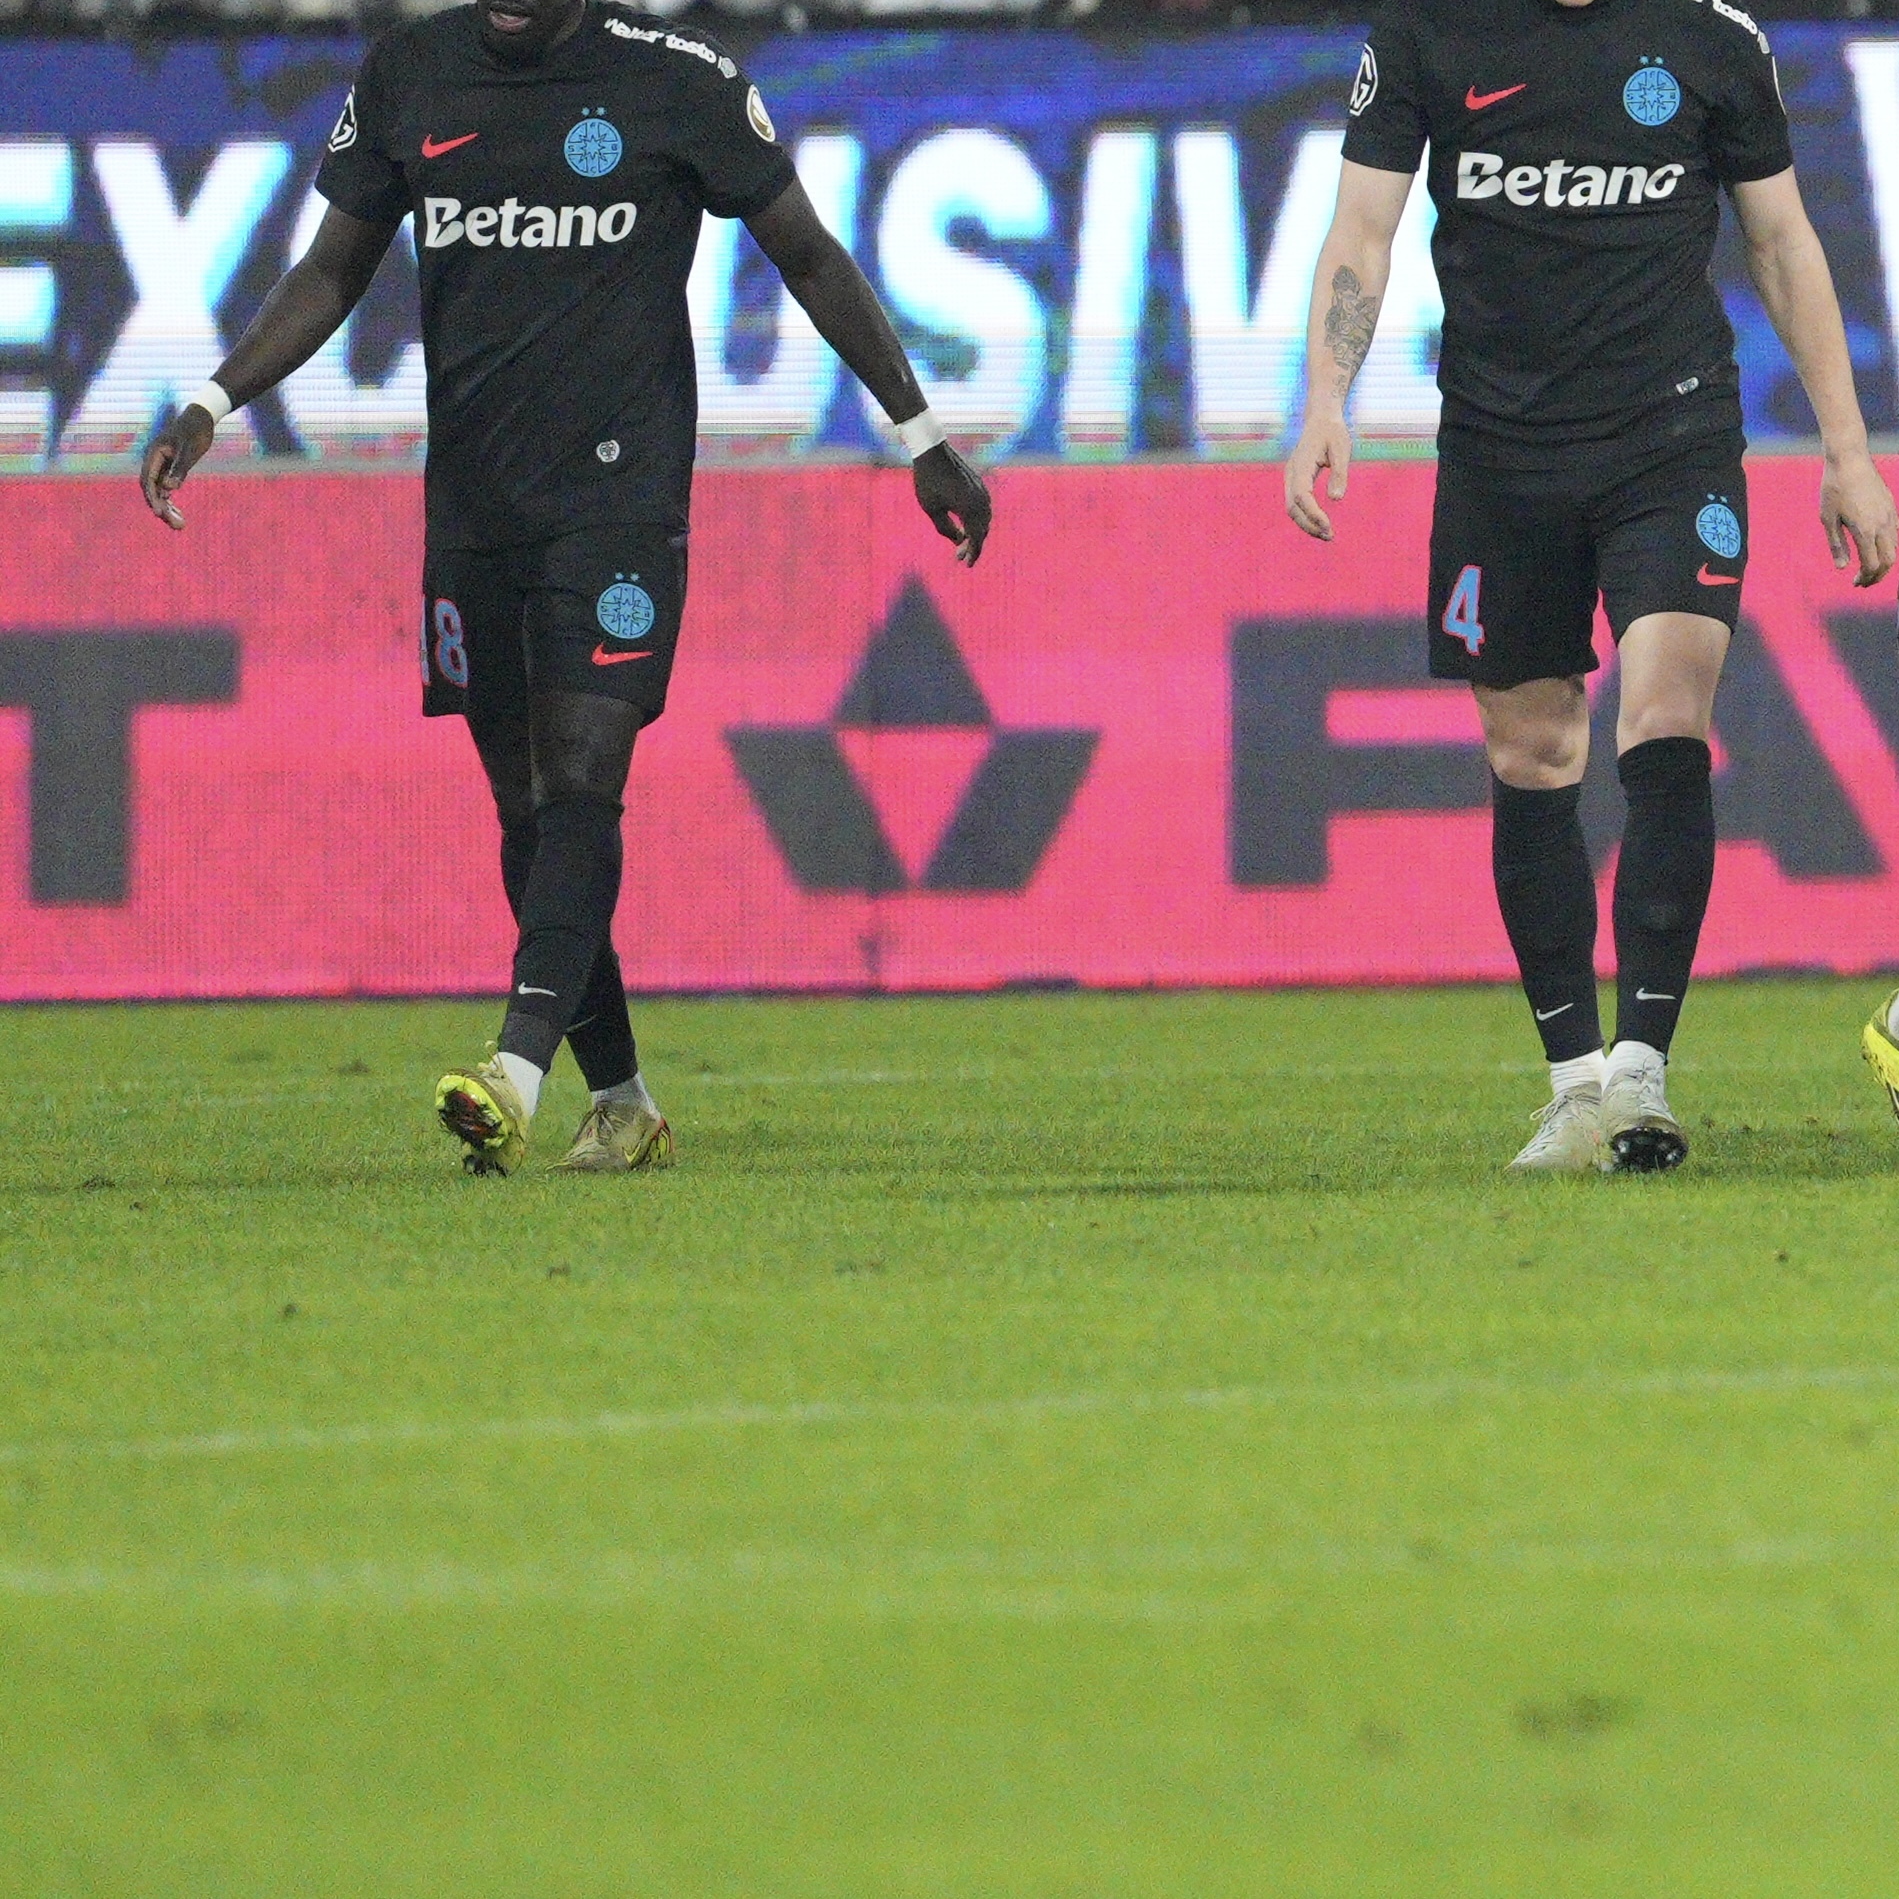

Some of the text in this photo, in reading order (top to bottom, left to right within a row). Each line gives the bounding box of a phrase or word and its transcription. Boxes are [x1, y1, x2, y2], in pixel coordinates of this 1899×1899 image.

[1457, 151, 1685, 208] Betano
[424, 196, 638, 249] Betano
[1443, 566, 1485, 655] 4
